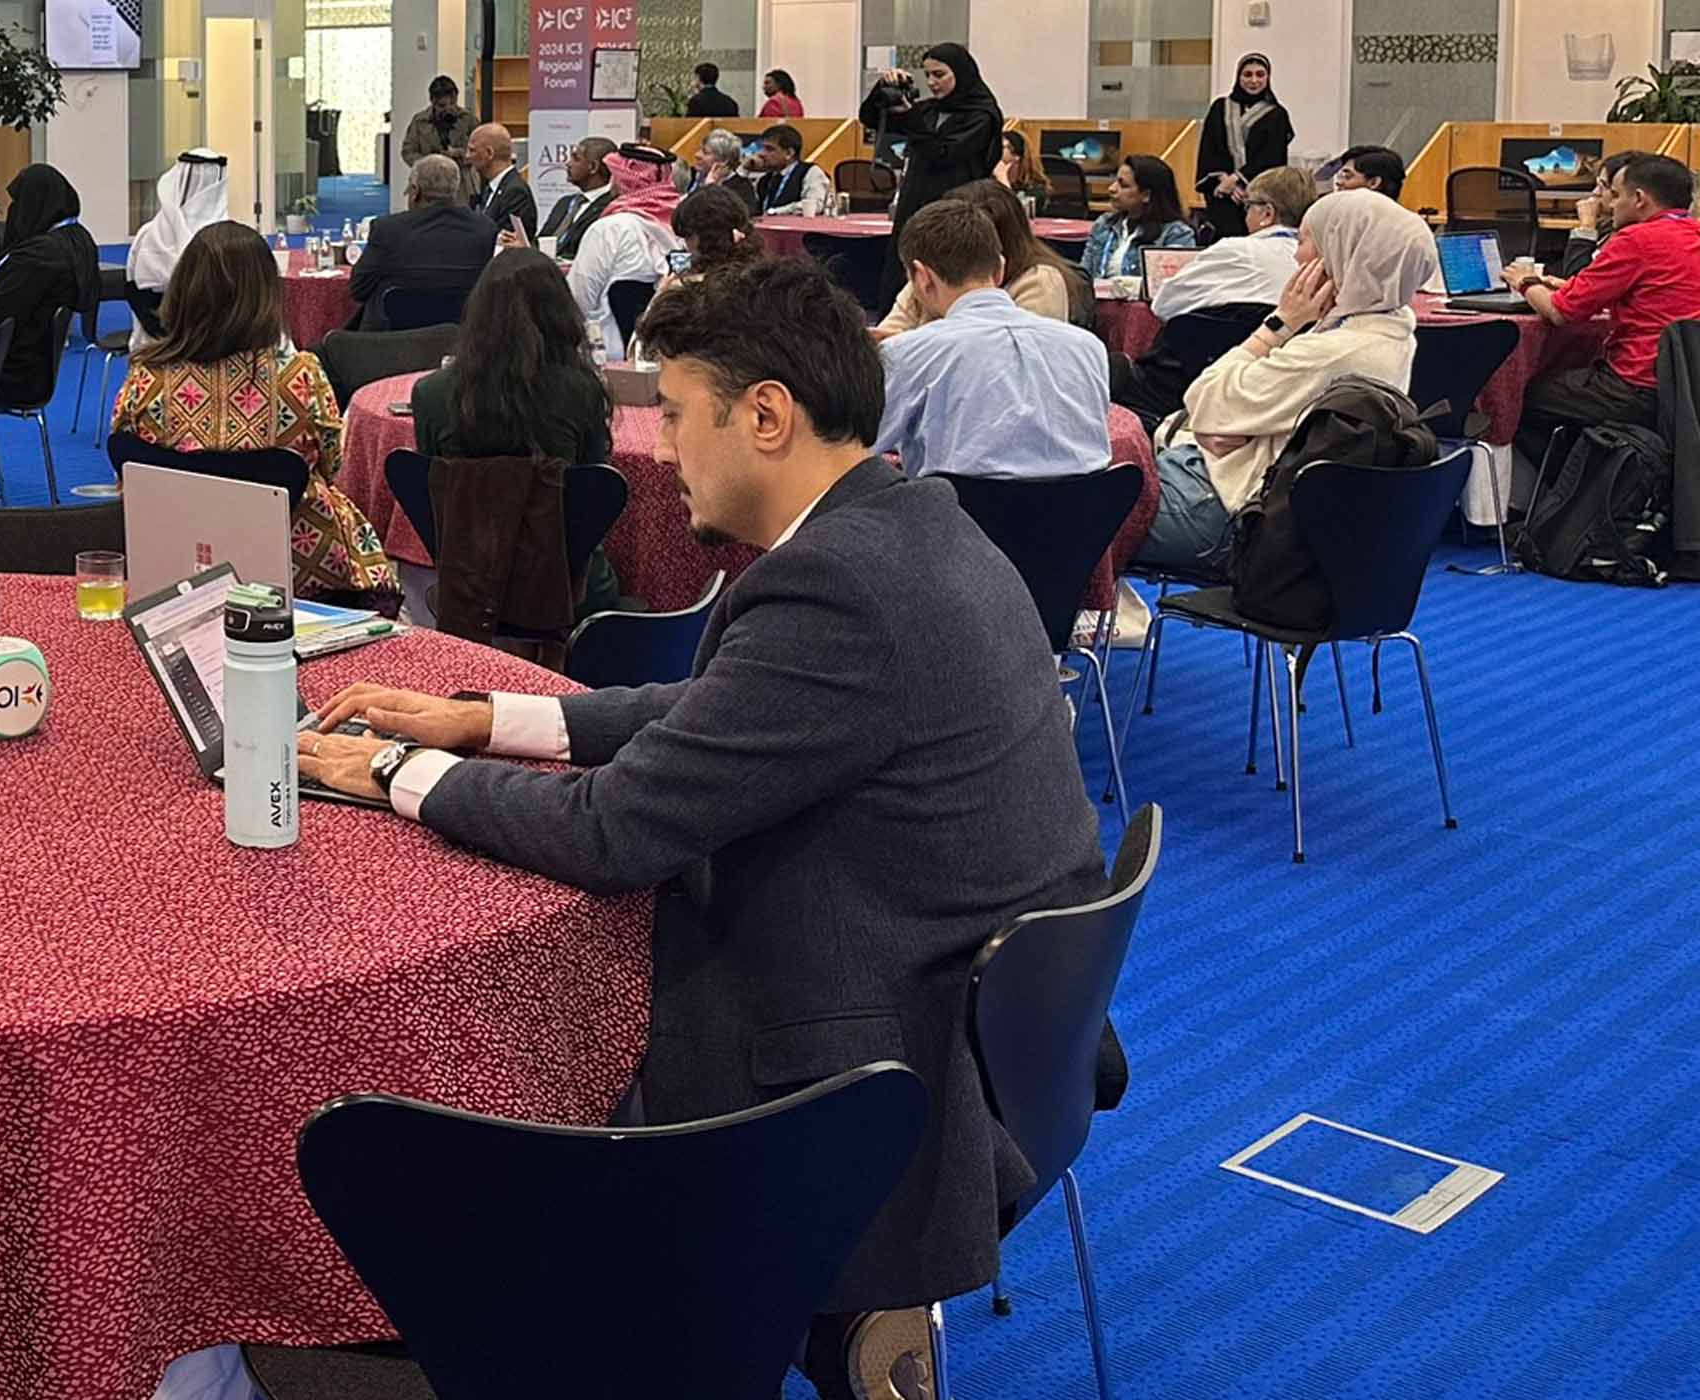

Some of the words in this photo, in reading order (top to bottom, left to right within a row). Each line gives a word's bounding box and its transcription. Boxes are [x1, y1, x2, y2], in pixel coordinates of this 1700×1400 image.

[539, 42, 564, 56] 2024
[539, 60, 582, 73] Regional
[544, 77, 577, 88] Forum
[270, 781, 282, 828] AVEX
